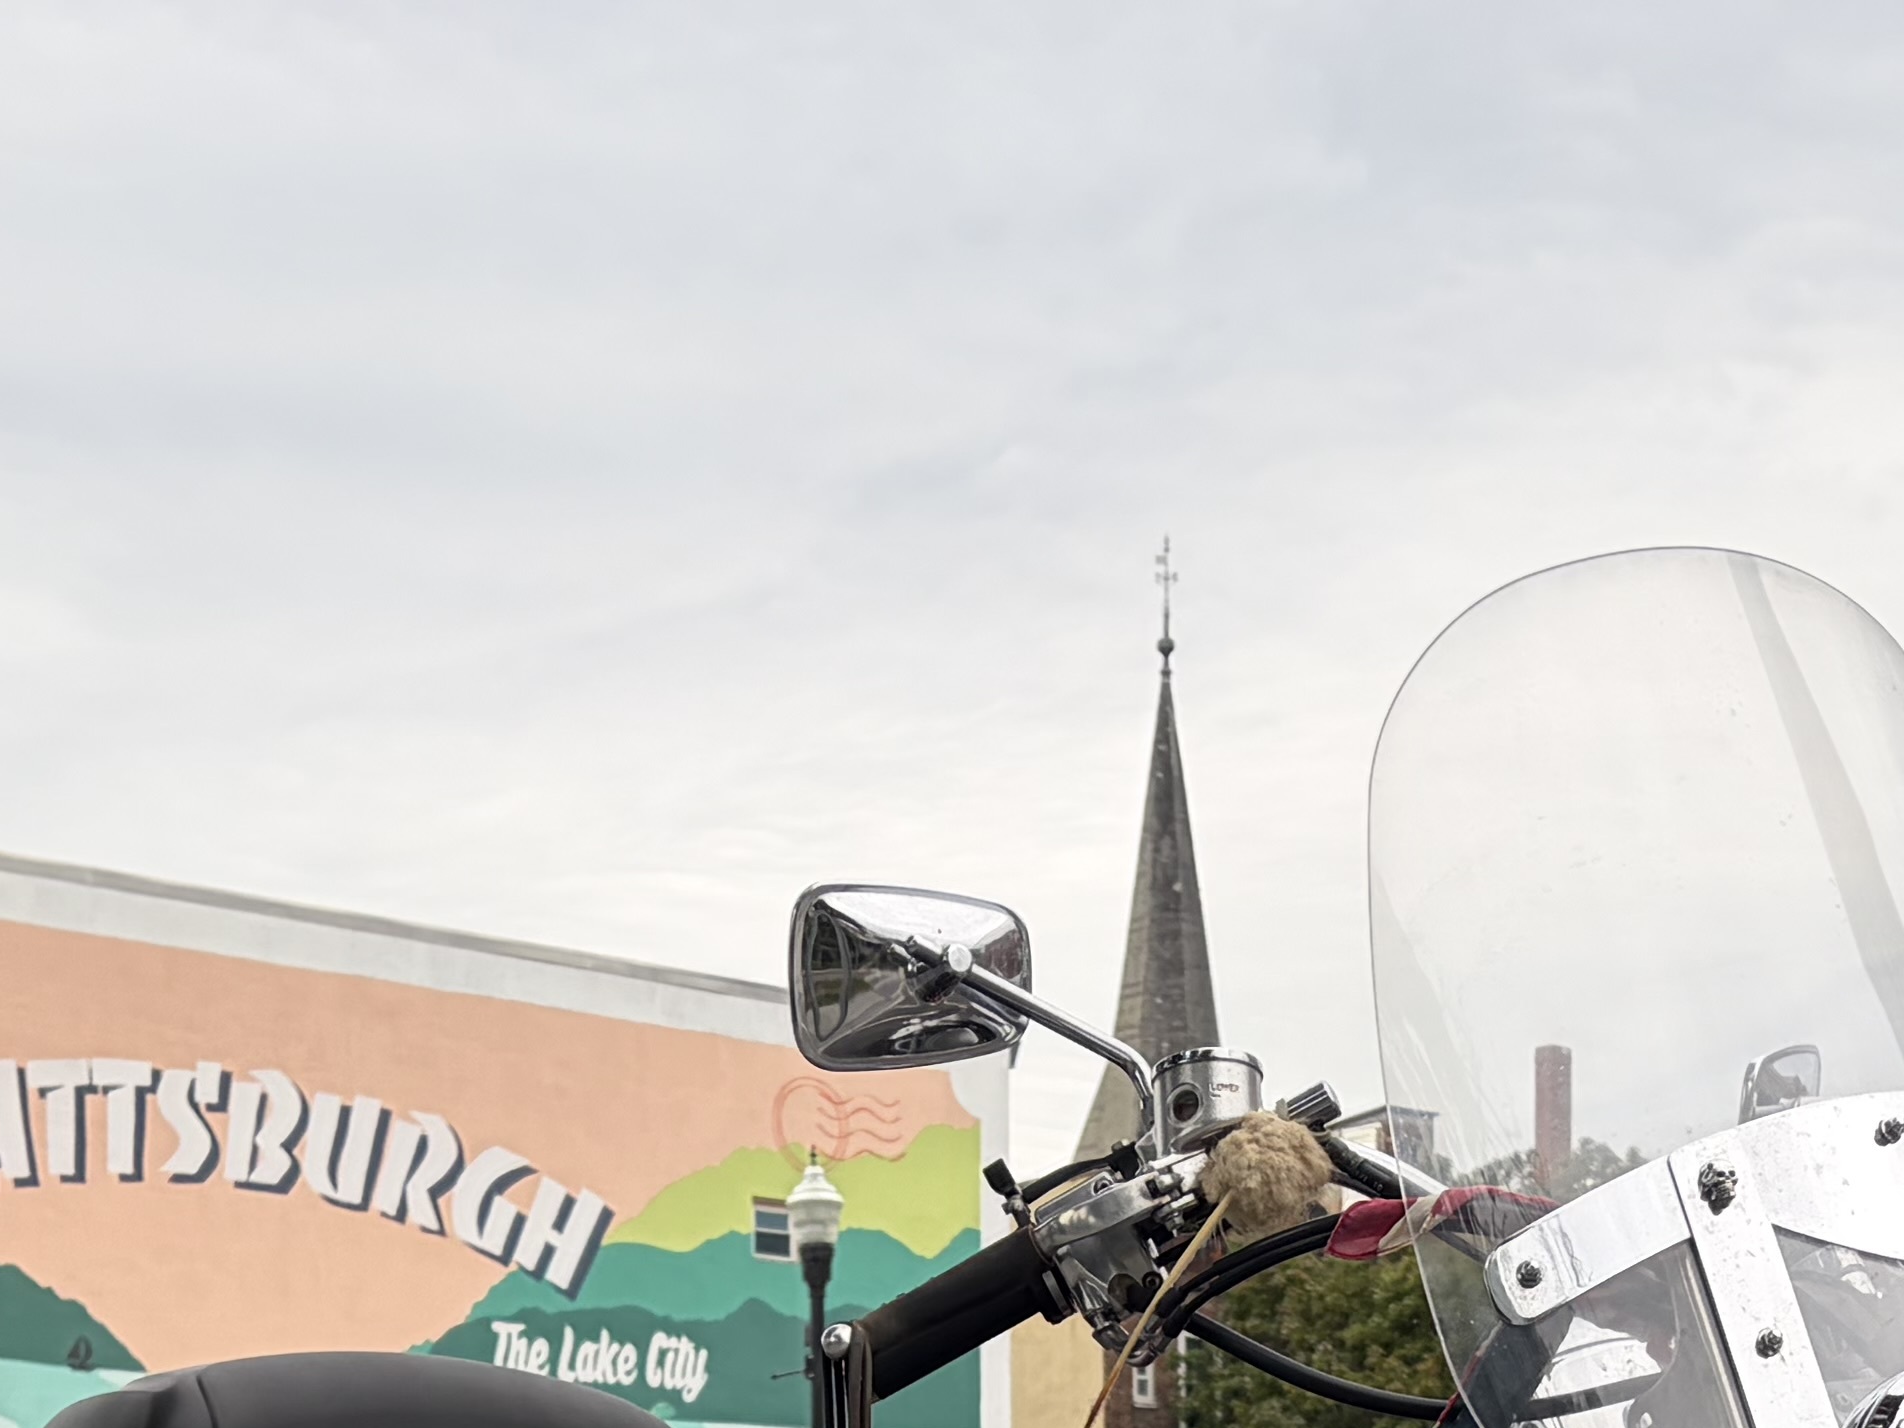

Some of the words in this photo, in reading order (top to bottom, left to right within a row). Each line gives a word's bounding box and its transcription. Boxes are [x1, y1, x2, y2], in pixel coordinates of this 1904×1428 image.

[491, 1321, 551, 1377] The
[557, 1324, 637, 1385] Lake
[645, 1331, 709, 1403] City
